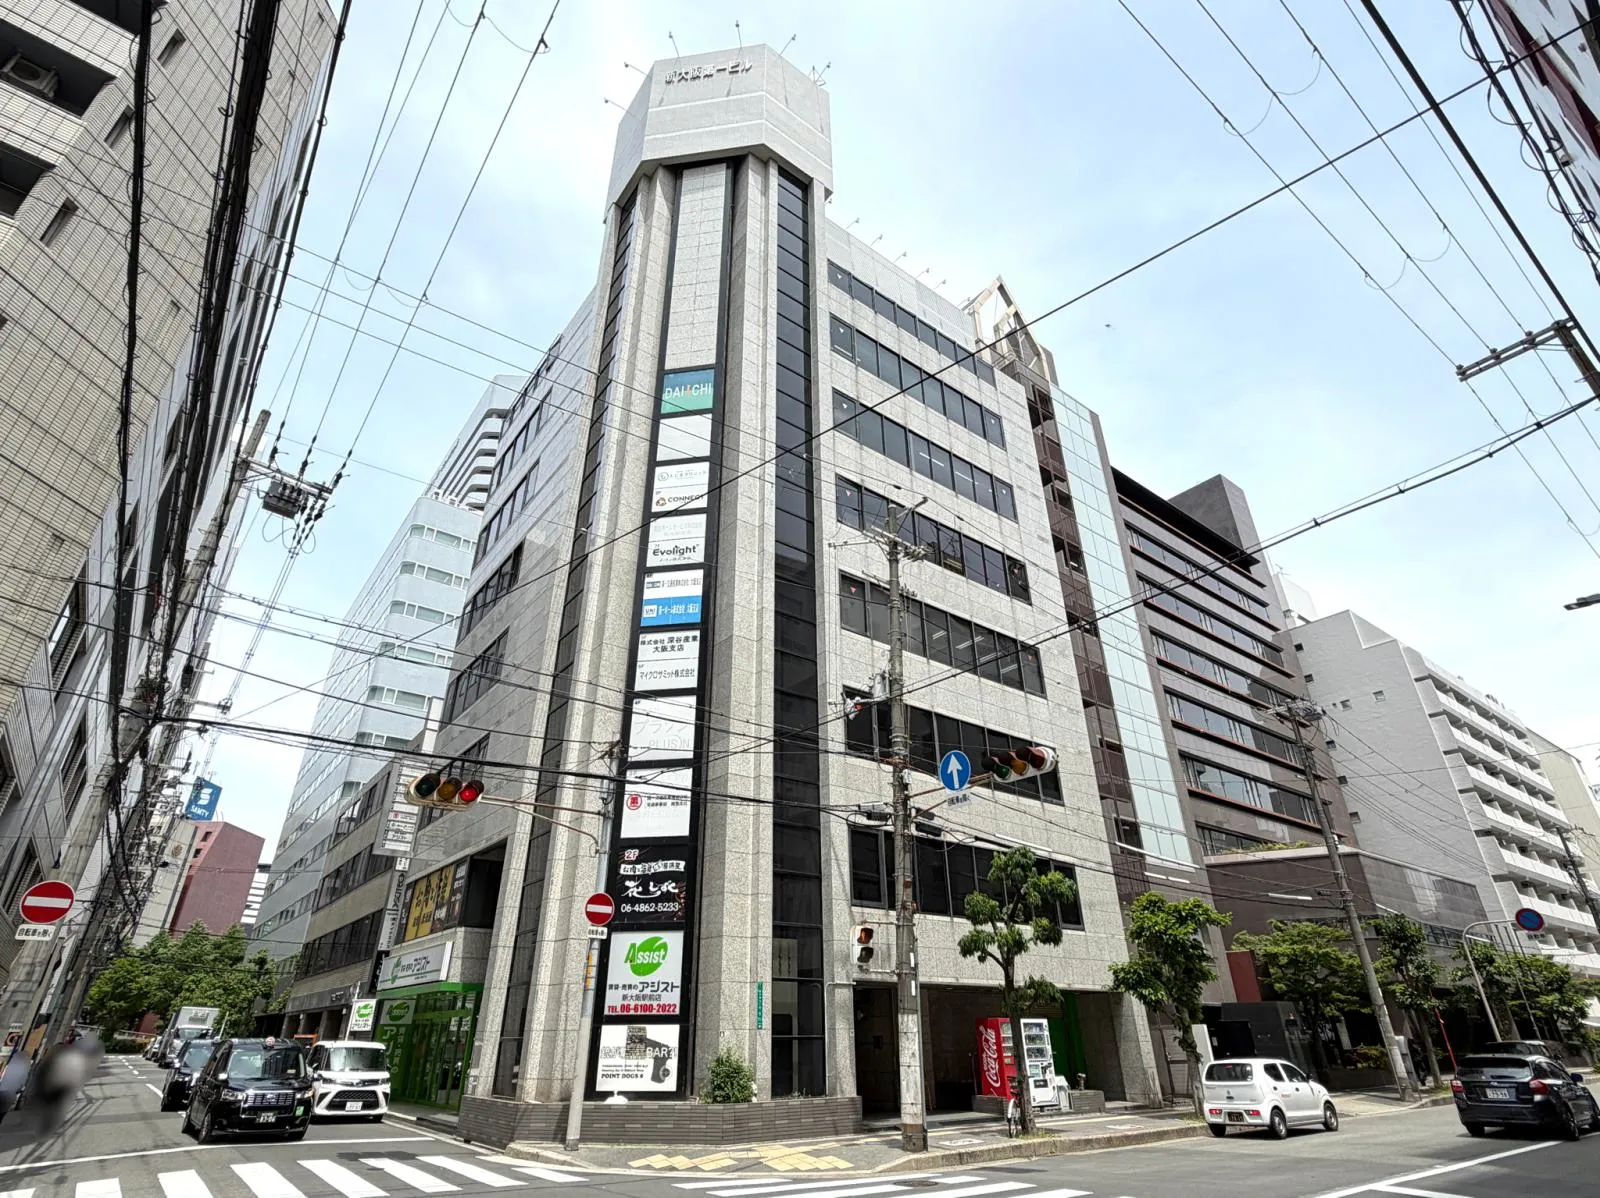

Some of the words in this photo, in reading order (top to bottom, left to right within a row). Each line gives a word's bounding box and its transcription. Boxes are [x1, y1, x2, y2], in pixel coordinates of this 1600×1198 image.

[652, 545, 697, 556] Evolight
[652, 644, 684, 653] 大阪支店
[624, 849, 639, 860] 2F
[620, 902, 679, 912] 06-4862-5233
[624, 942, 666, 964] Assist
[620, 1003, 677, 1013] 06-6100-2022
